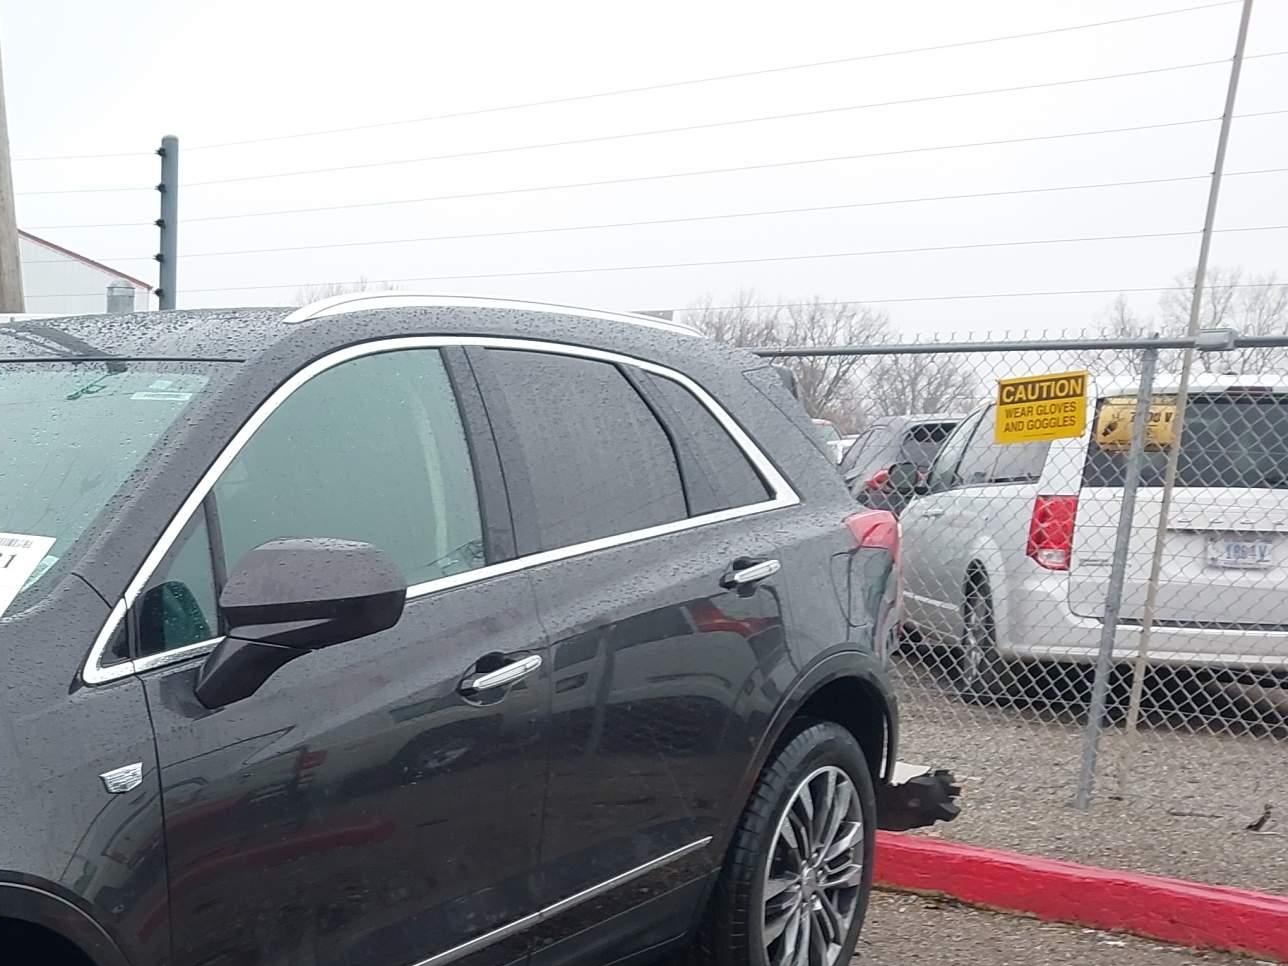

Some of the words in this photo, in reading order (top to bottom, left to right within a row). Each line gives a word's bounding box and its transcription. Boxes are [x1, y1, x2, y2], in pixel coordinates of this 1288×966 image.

[1002, 379, 1082, 403] CAUTION
[1005, 406, 1034, 419] WEAR
[1036, 401, 1077, 415] GLOVES
[1004, 420, 1025, 433] AND
[1027, 415, 1076, 431] GOGGLES
